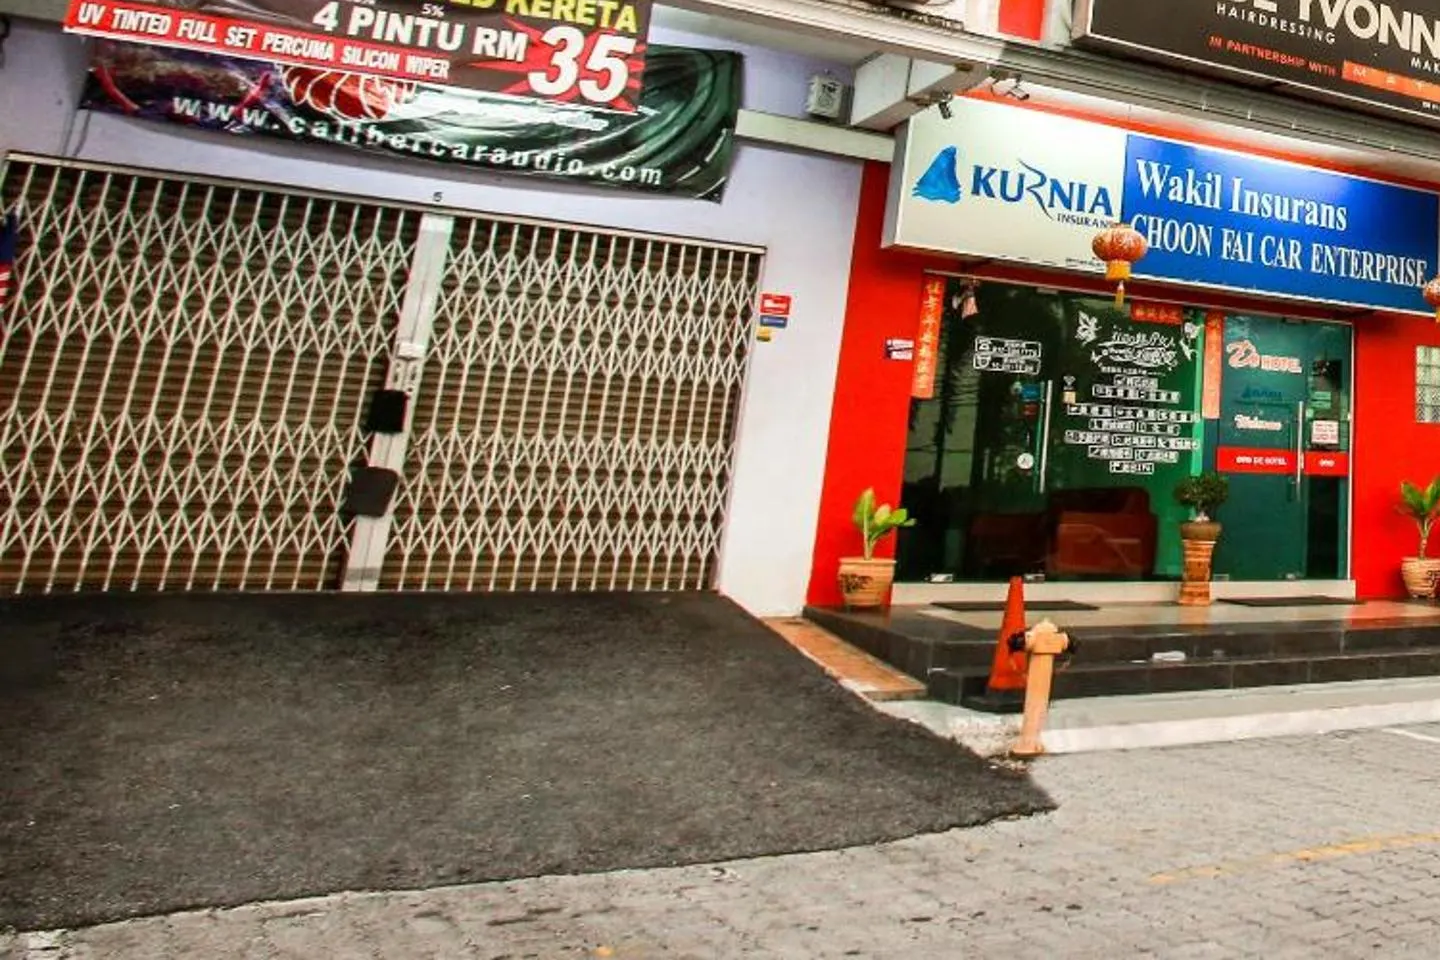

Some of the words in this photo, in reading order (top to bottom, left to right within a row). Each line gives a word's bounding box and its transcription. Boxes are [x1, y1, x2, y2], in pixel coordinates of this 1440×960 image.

[77, 1, 105, 25] UV
[112, 6, 172, 36] TINTED
[177, 16, 218, 44] FULL
[224, 24, 257, 50] SET
[261, 31, 335, 62] PERCUMA
[342, 45, 400, 71] SILICON
[405, 54, 451, 79] WIPER
[422, 2, 444, 18] 5%
[1215, 2, 1337, 45] HAIRDRESSING
[312, 1, 340, 32] 4
[348, 6, 465, 52] PINTU
[472, 27, 528, 62] RM
[528, 25, 638, 104] 35
[1208, 36, 1222, 48] IN
[1226, 40, 1306, 69] PARTNERSHIP
[1308, 60, 1337, 78] WITH
[971, 158, 1114, 221] KURNIA
[1057, 211, 1112, 230] INSURAN
[1136, 158, 1222, 210] Wakil
[1229, 177, 1348, 232] Insurans
[1131, 213, 1214, 259] CHOON
[1221, 227, 1255, 264] FAI
[1260, 235, 1303, 271] CAR
[1310, 242, 1429, 289] ENTERPRISE
